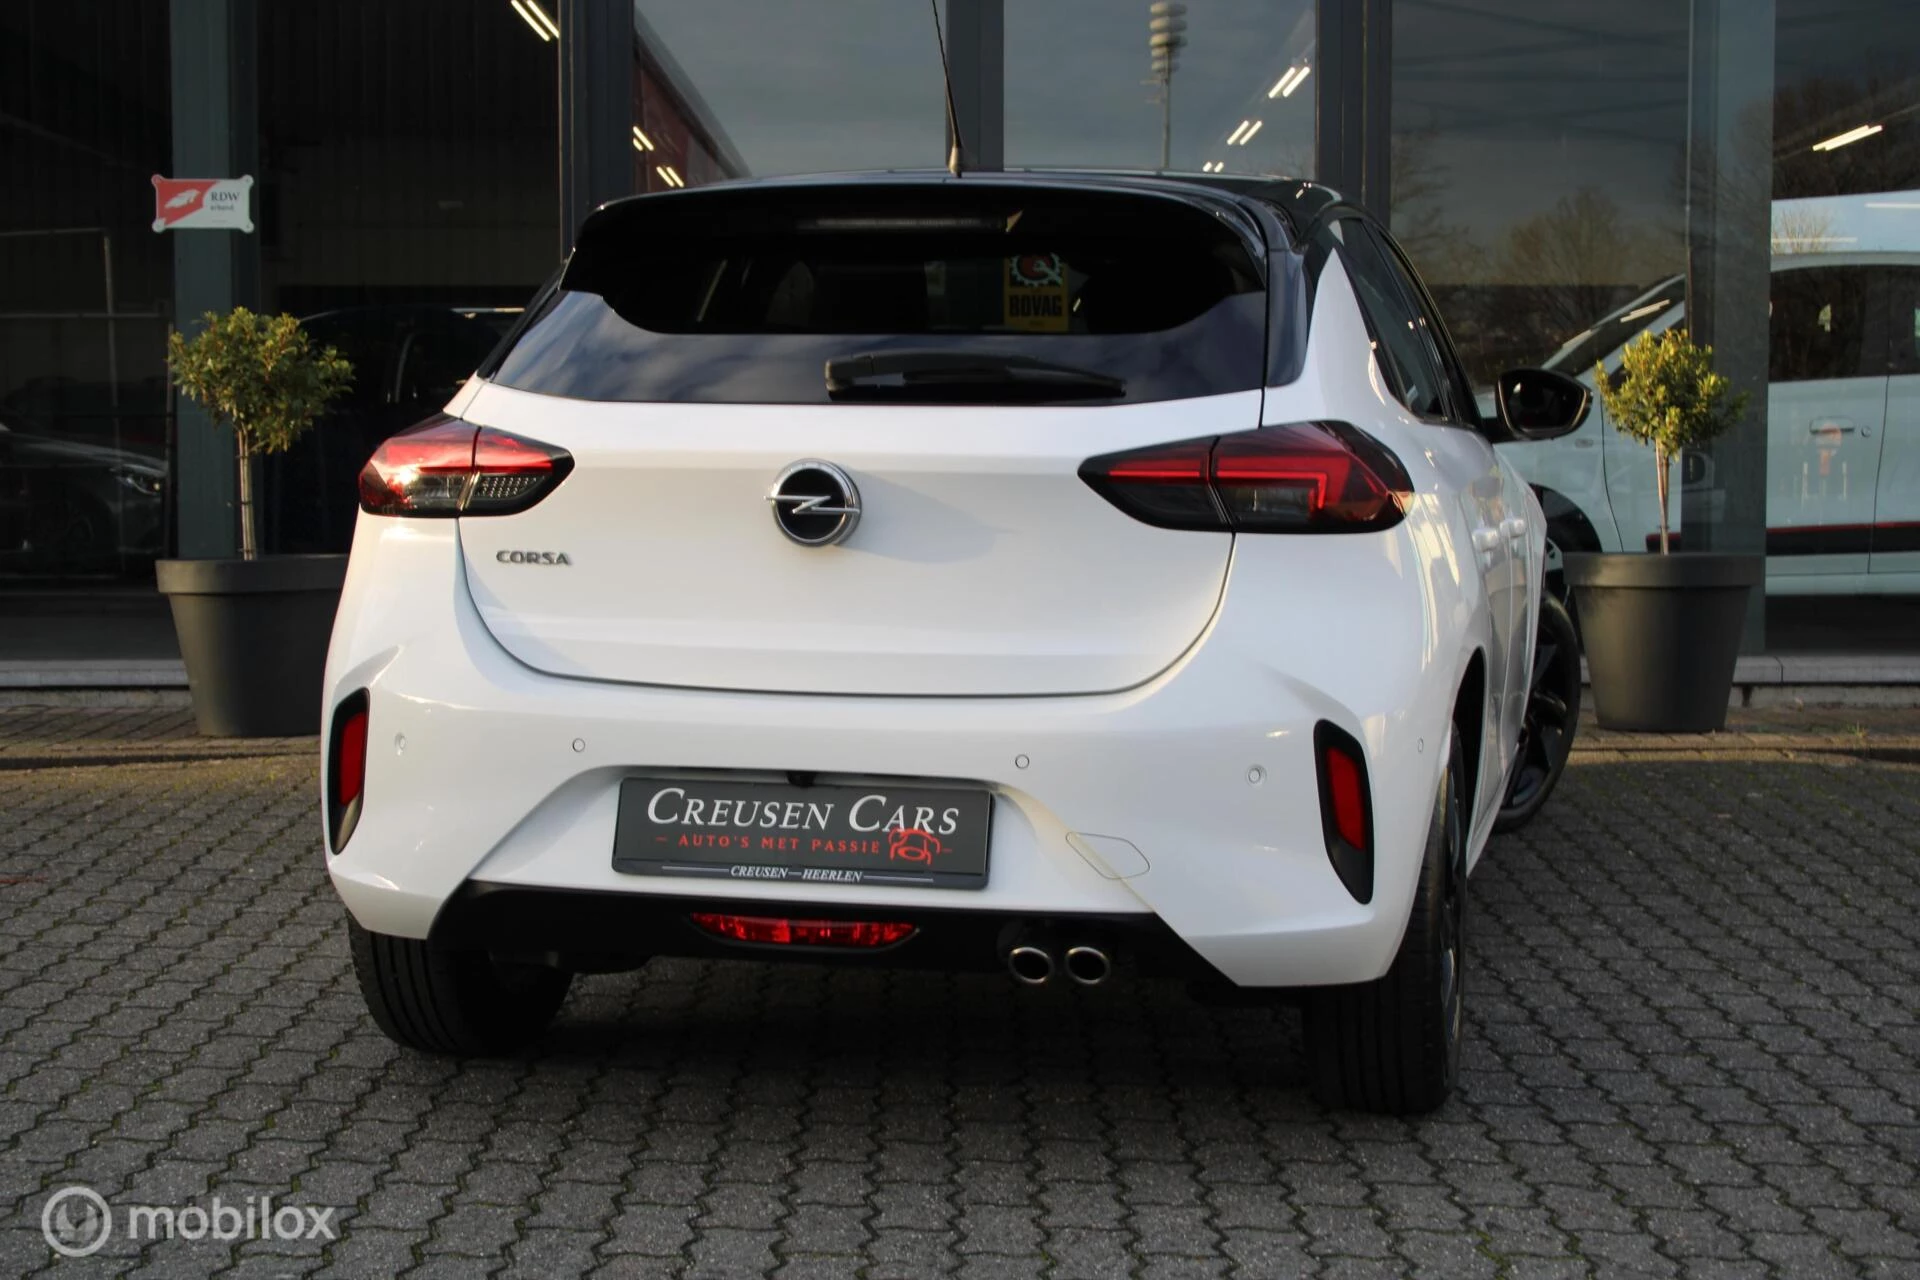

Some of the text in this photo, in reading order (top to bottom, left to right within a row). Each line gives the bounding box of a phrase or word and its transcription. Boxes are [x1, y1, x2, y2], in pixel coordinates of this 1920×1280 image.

[211, 191, 240, 202] RDW
[1009, 295, 1062, 317] BOVAG
[496, 550, 571, 566] CORSA
[678, 832, 880, 854] AUTO'S MET PASSIE
